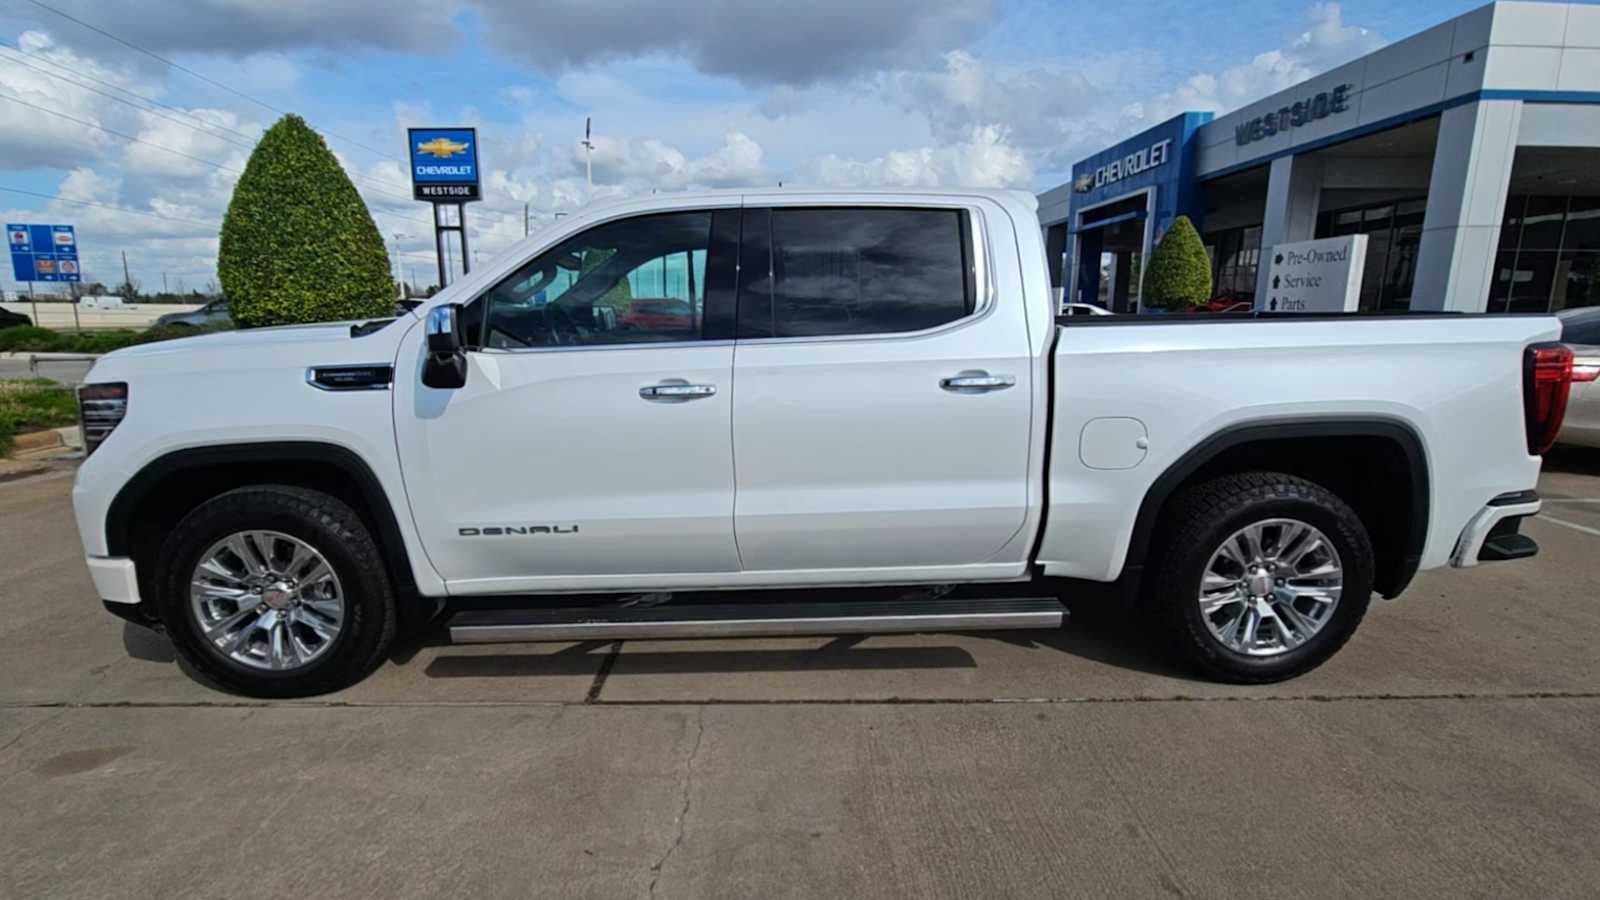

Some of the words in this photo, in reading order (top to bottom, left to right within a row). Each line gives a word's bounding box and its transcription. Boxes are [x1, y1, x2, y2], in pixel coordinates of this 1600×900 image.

[1235, 84, 1354, 146] WESTSIDE
[416, 166, 472, 175] CHEVROLET
[1095, 138, 1171, 188] CHEVROLET
[422, 187, 470, 195] WESTSIDE
[1287, 245, 1348, 265] Pre-Owned
[1283, 272, 1322, 288] Service
[1281, 296, 1305, 311] Parts
[458, 524, 579, 536] DENALI
